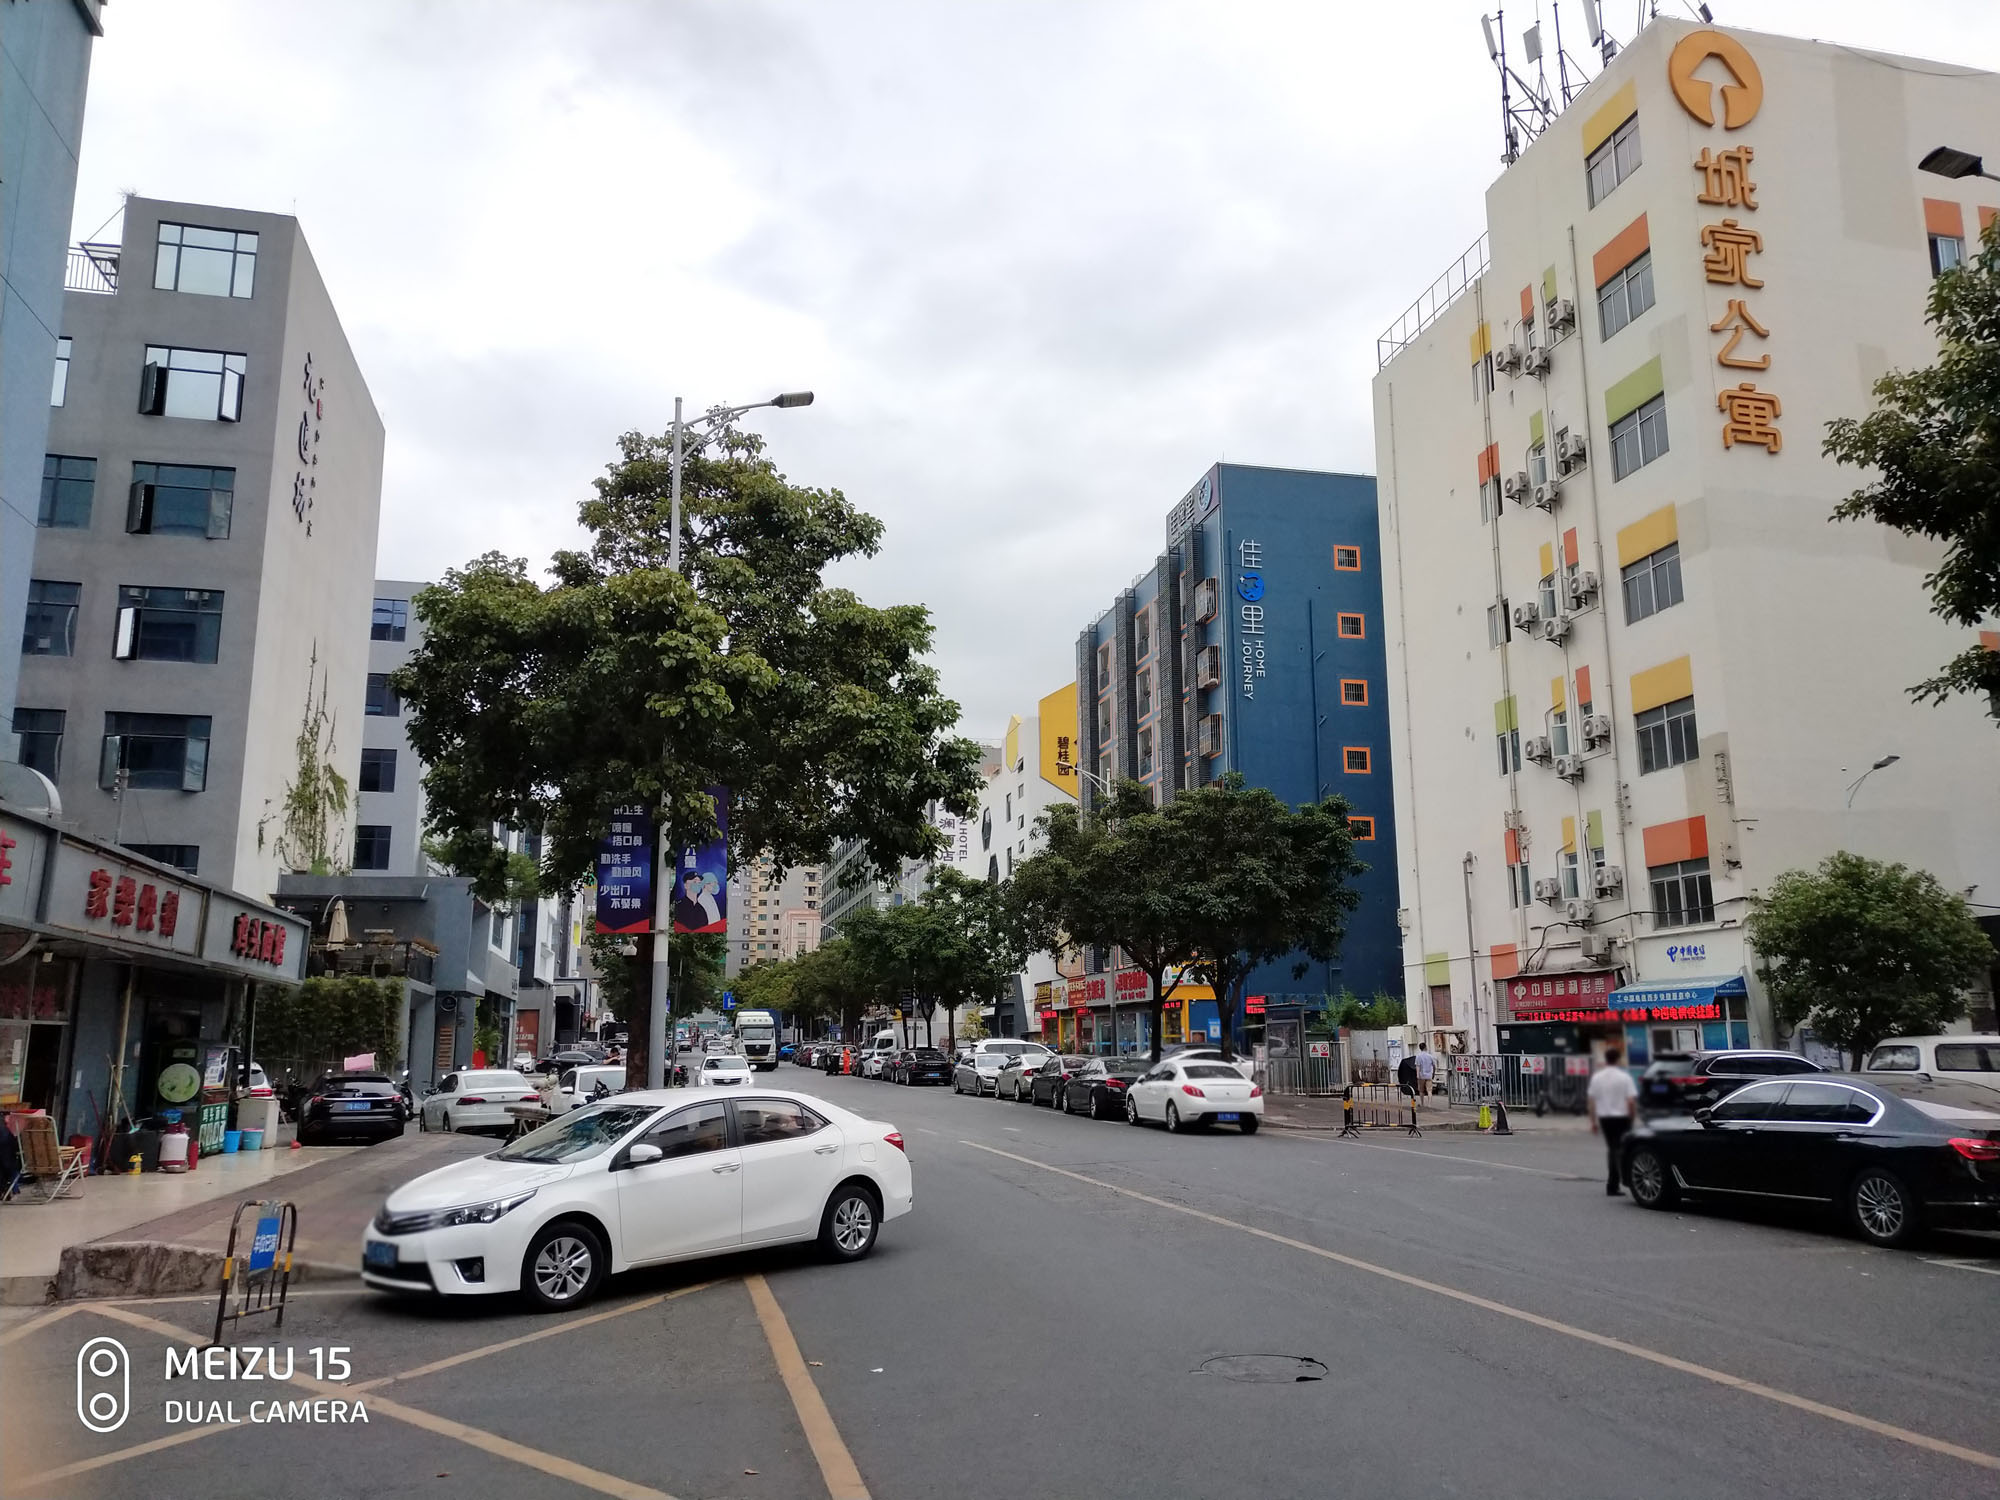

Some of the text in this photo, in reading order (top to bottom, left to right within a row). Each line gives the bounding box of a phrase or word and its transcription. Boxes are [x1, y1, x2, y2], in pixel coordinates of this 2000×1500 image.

[1694, 144, 1782, 454] 城家公寓
[1254, 639, 1267, 679] HOME
[1240, 638, 1255, 701] JOURNEY
[1057, 736, 1070, 776] 碧桂园
[608, 822, 633, 834] 喷嚏
[612, 835, 643, 847] 捂口鼻
[958, 827, 968, 862] HOTEL
[600, 853, 632, 865] 勤洗手
[611, 866, 642, 878] 勤通风
[599, 884, 631, 896] 少出门
[610, 898, 642, 910] 不聚集
